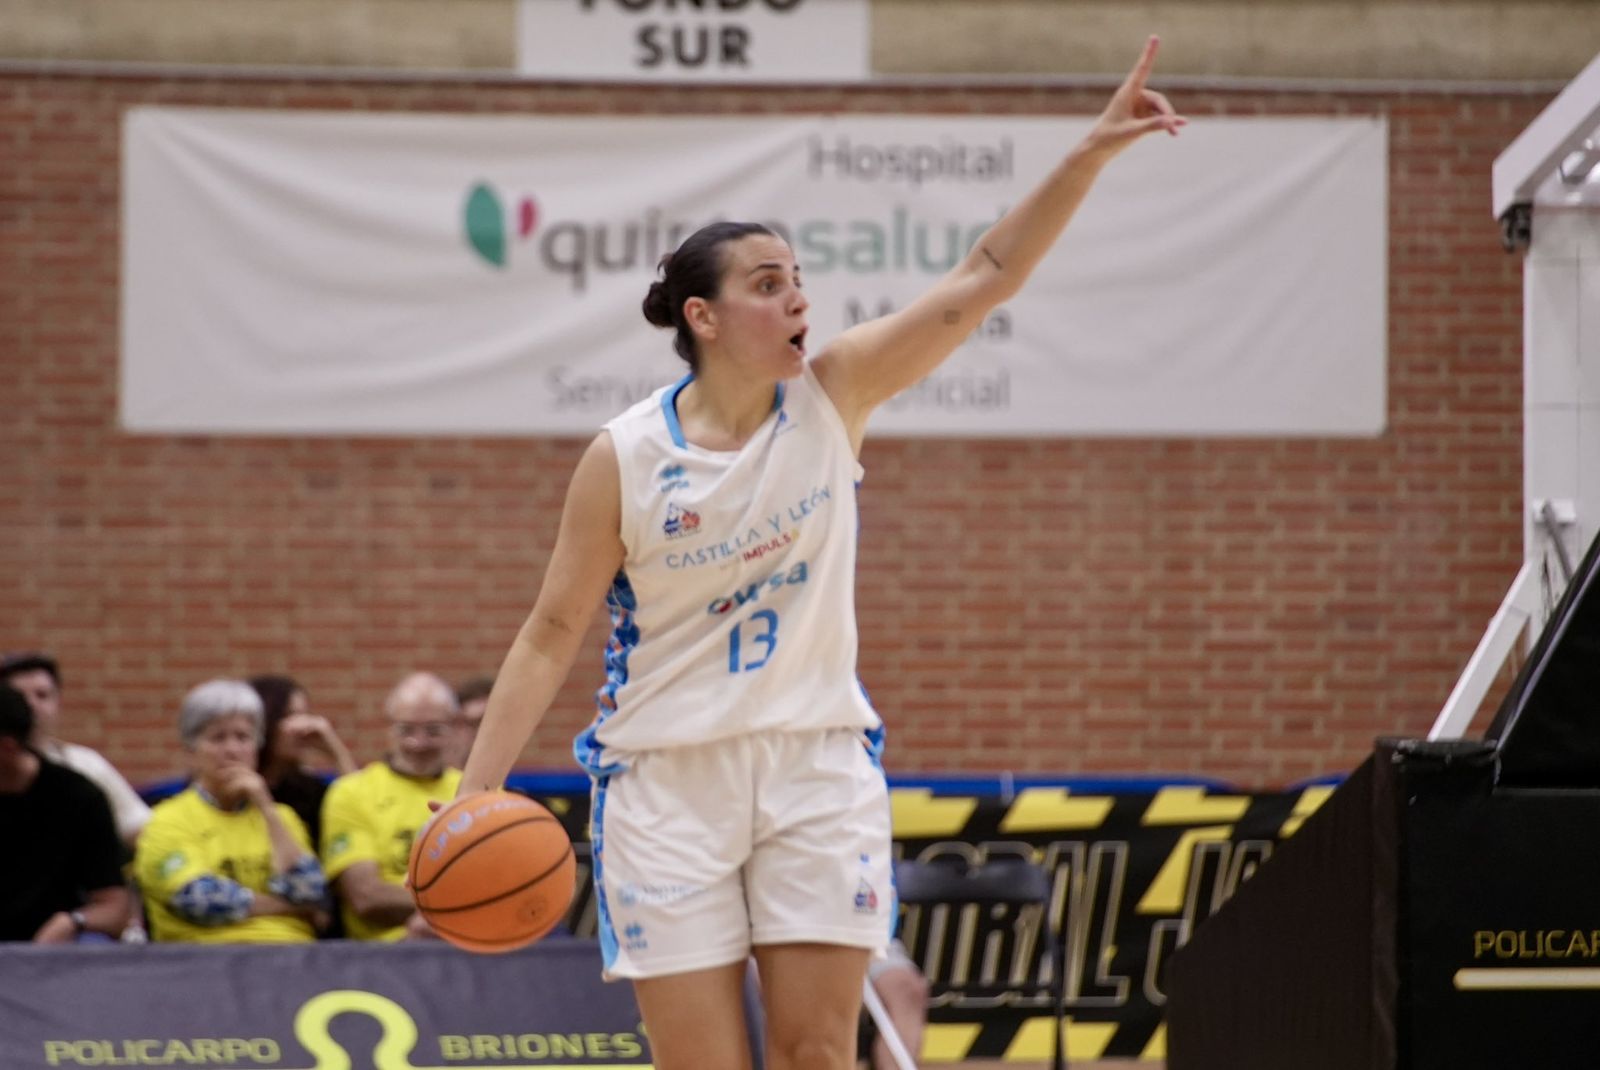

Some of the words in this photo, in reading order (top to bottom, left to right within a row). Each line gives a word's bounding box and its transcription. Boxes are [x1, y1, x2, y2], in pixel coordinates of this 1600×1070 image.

[635, 24, 752, 68] SUR
[806, 135, 1014, 188] Hospital
[665, 527, 761, 569] CASTILLA
[767, 513, 781, 533] Y
[788, 485, 831, 521] LEÓN
[728, 608, 779, 673] 13
[44, 1038, 281, 1066] POLICARPO
[438, 1032, 642, 1061] BRIONES
